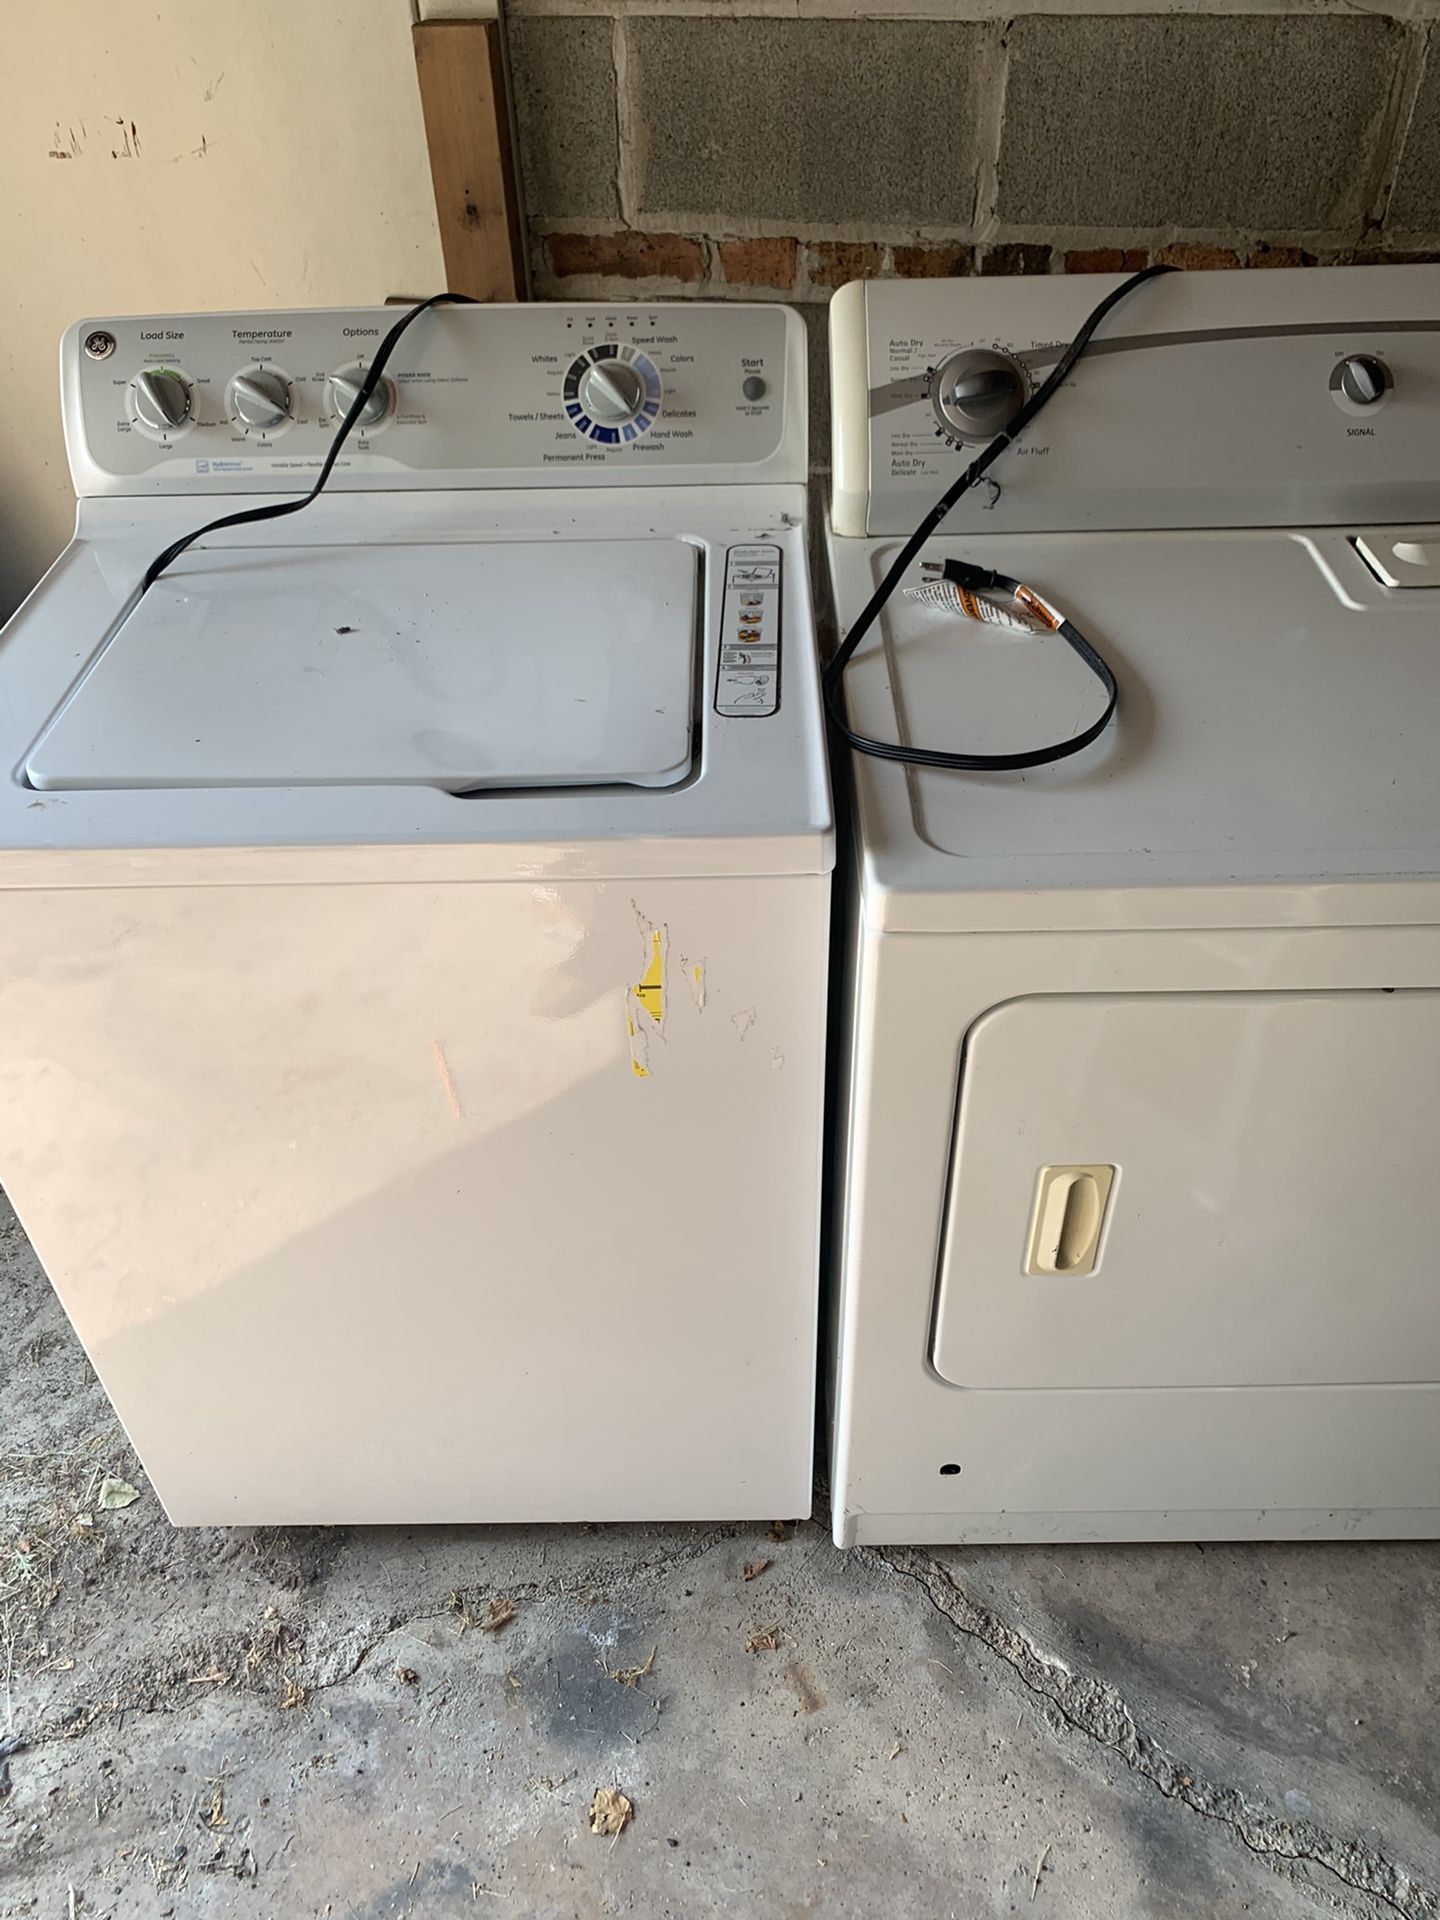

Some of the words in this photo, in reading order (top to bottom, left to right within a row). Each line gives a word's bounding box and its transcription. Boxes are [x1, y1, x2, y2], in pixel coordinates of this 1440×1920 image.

[140, 332, 164, 340] Load
[166, 331, 184, 340] Size
[232, 330, 292, 340] Temperature
[342, 328, 379, 338] Options
[632, 336, 655, 345] Speed
[656, 336, 678, 344] Wash
[910, 339, 924, 348] Dry
[741, 358, 764, 368] Start
[509, 413, 534, 421] Towels
[540, 412, 564, 421] Sheets
[555, 432, 576, 440] Jeans
[650, 430, 670, 438] Hand
[672, 430, 694, 438] Wash
[1346, 428, 1375, 436] SIGNAL
[1016, 448, 1028, 456] Air
[1030, 447, 1050, 455] Fluff
[543, 453, 584, 462] Permanent
[891, 459, 910, 467] Auto
[912, 459, 926, 468] Dry
